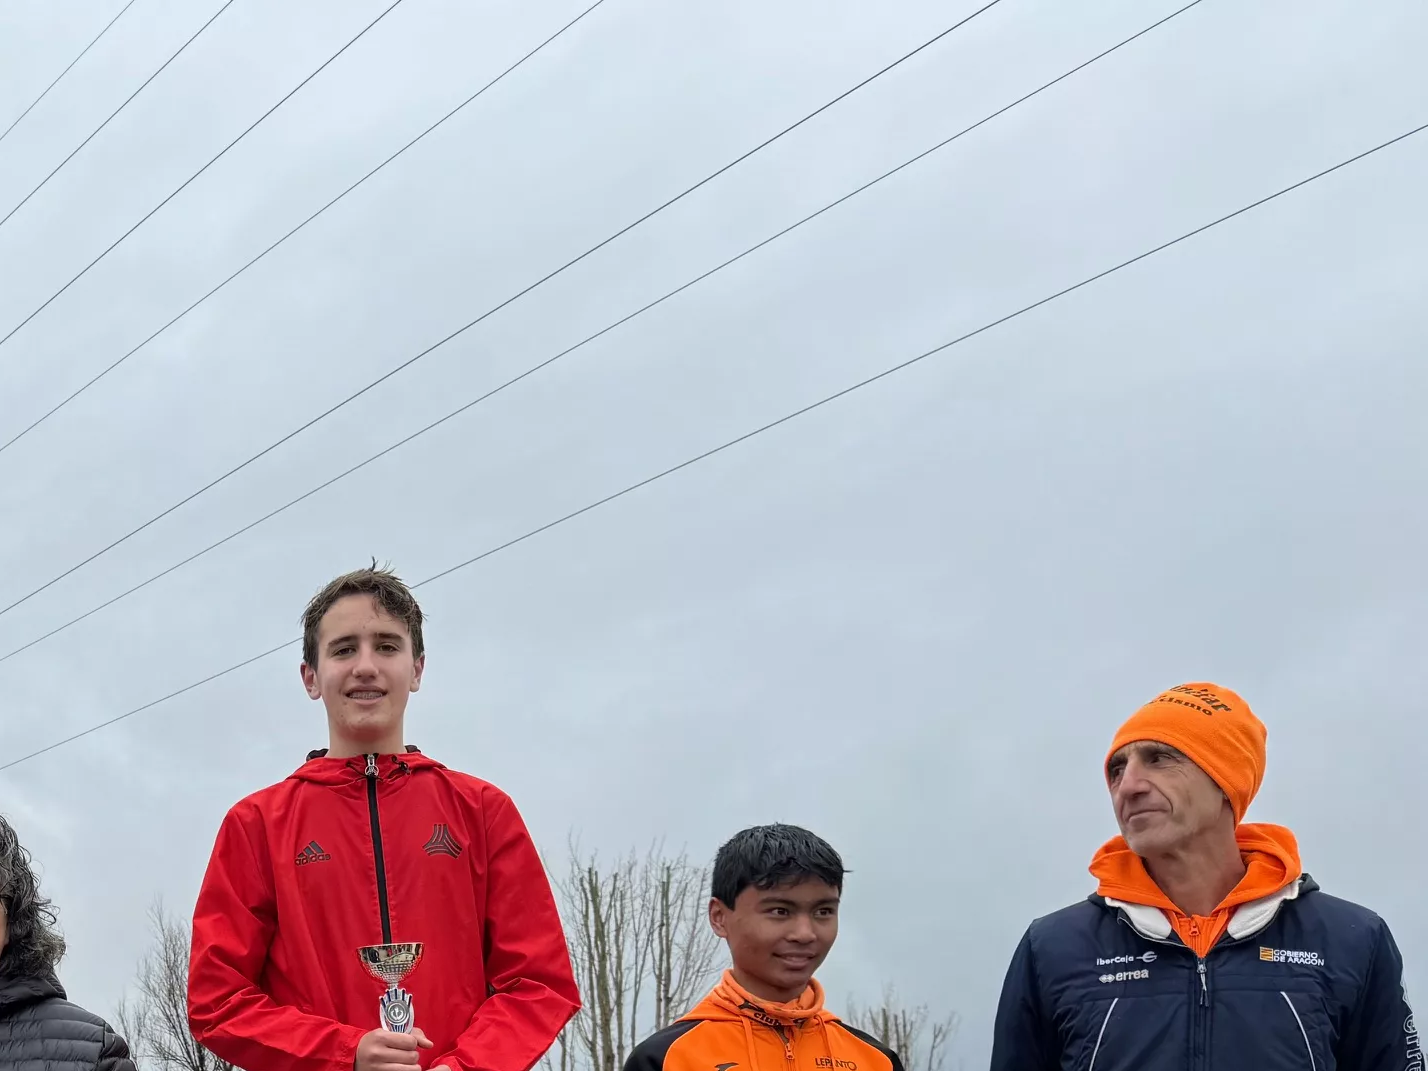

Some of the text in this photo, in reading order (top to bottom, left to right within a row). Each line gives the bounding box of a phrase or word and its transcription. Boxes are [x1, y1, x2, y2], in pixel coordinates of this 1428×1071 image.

[295, 853, 331, 866] adidas
[1273, 949, 1318, 959] GOBIERNO
[1273, 955, 1286, 963] DE
[1116, 969, 1149, 981] errea
